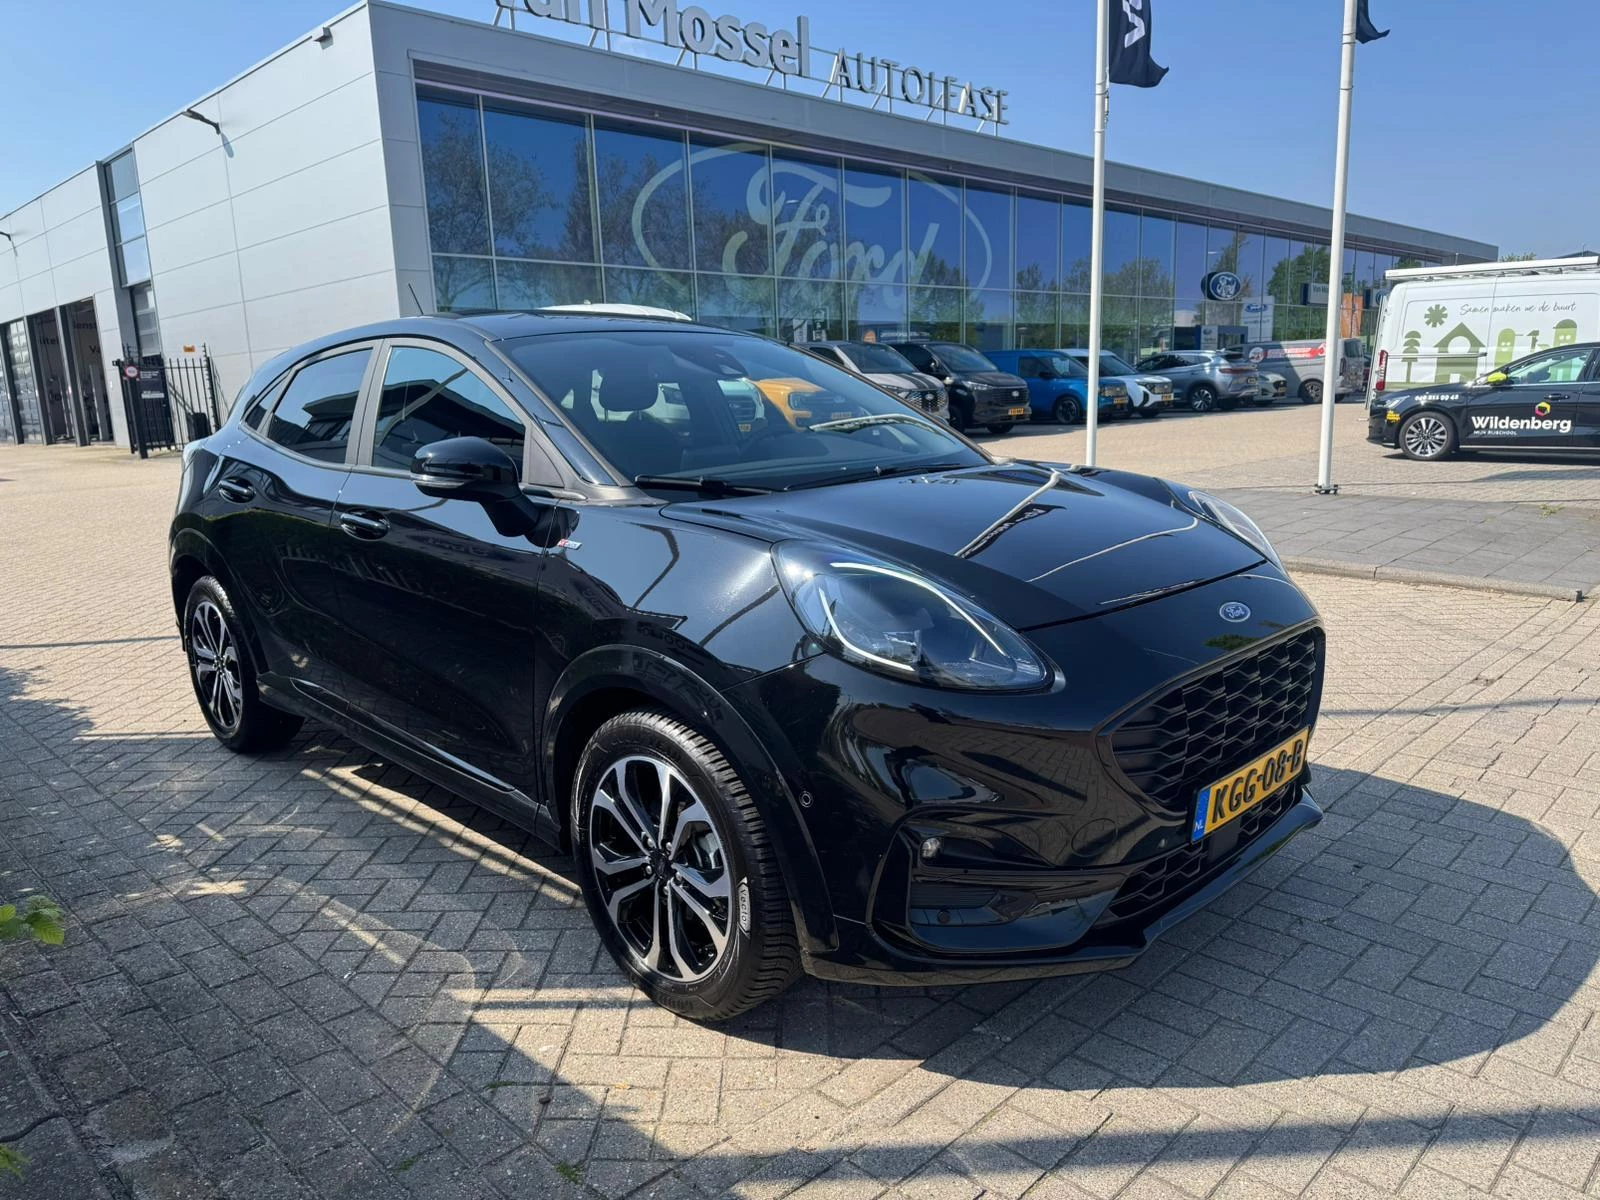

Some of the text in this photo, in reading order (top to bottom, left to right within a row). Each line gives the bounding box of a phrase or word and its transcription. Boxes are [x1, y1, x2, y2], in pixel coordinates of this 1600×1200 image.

[625, 0, 810, 77] Mossel
[831, 48, 1009, 125] AUTOLEASE
[722, 161, 940, 310] Ford
[1216, 275, 1237, 298] Ford
[1471, 416, 1572, 433] Wildenberg
[1211, 739, 1304, 824] KGG-08-B
